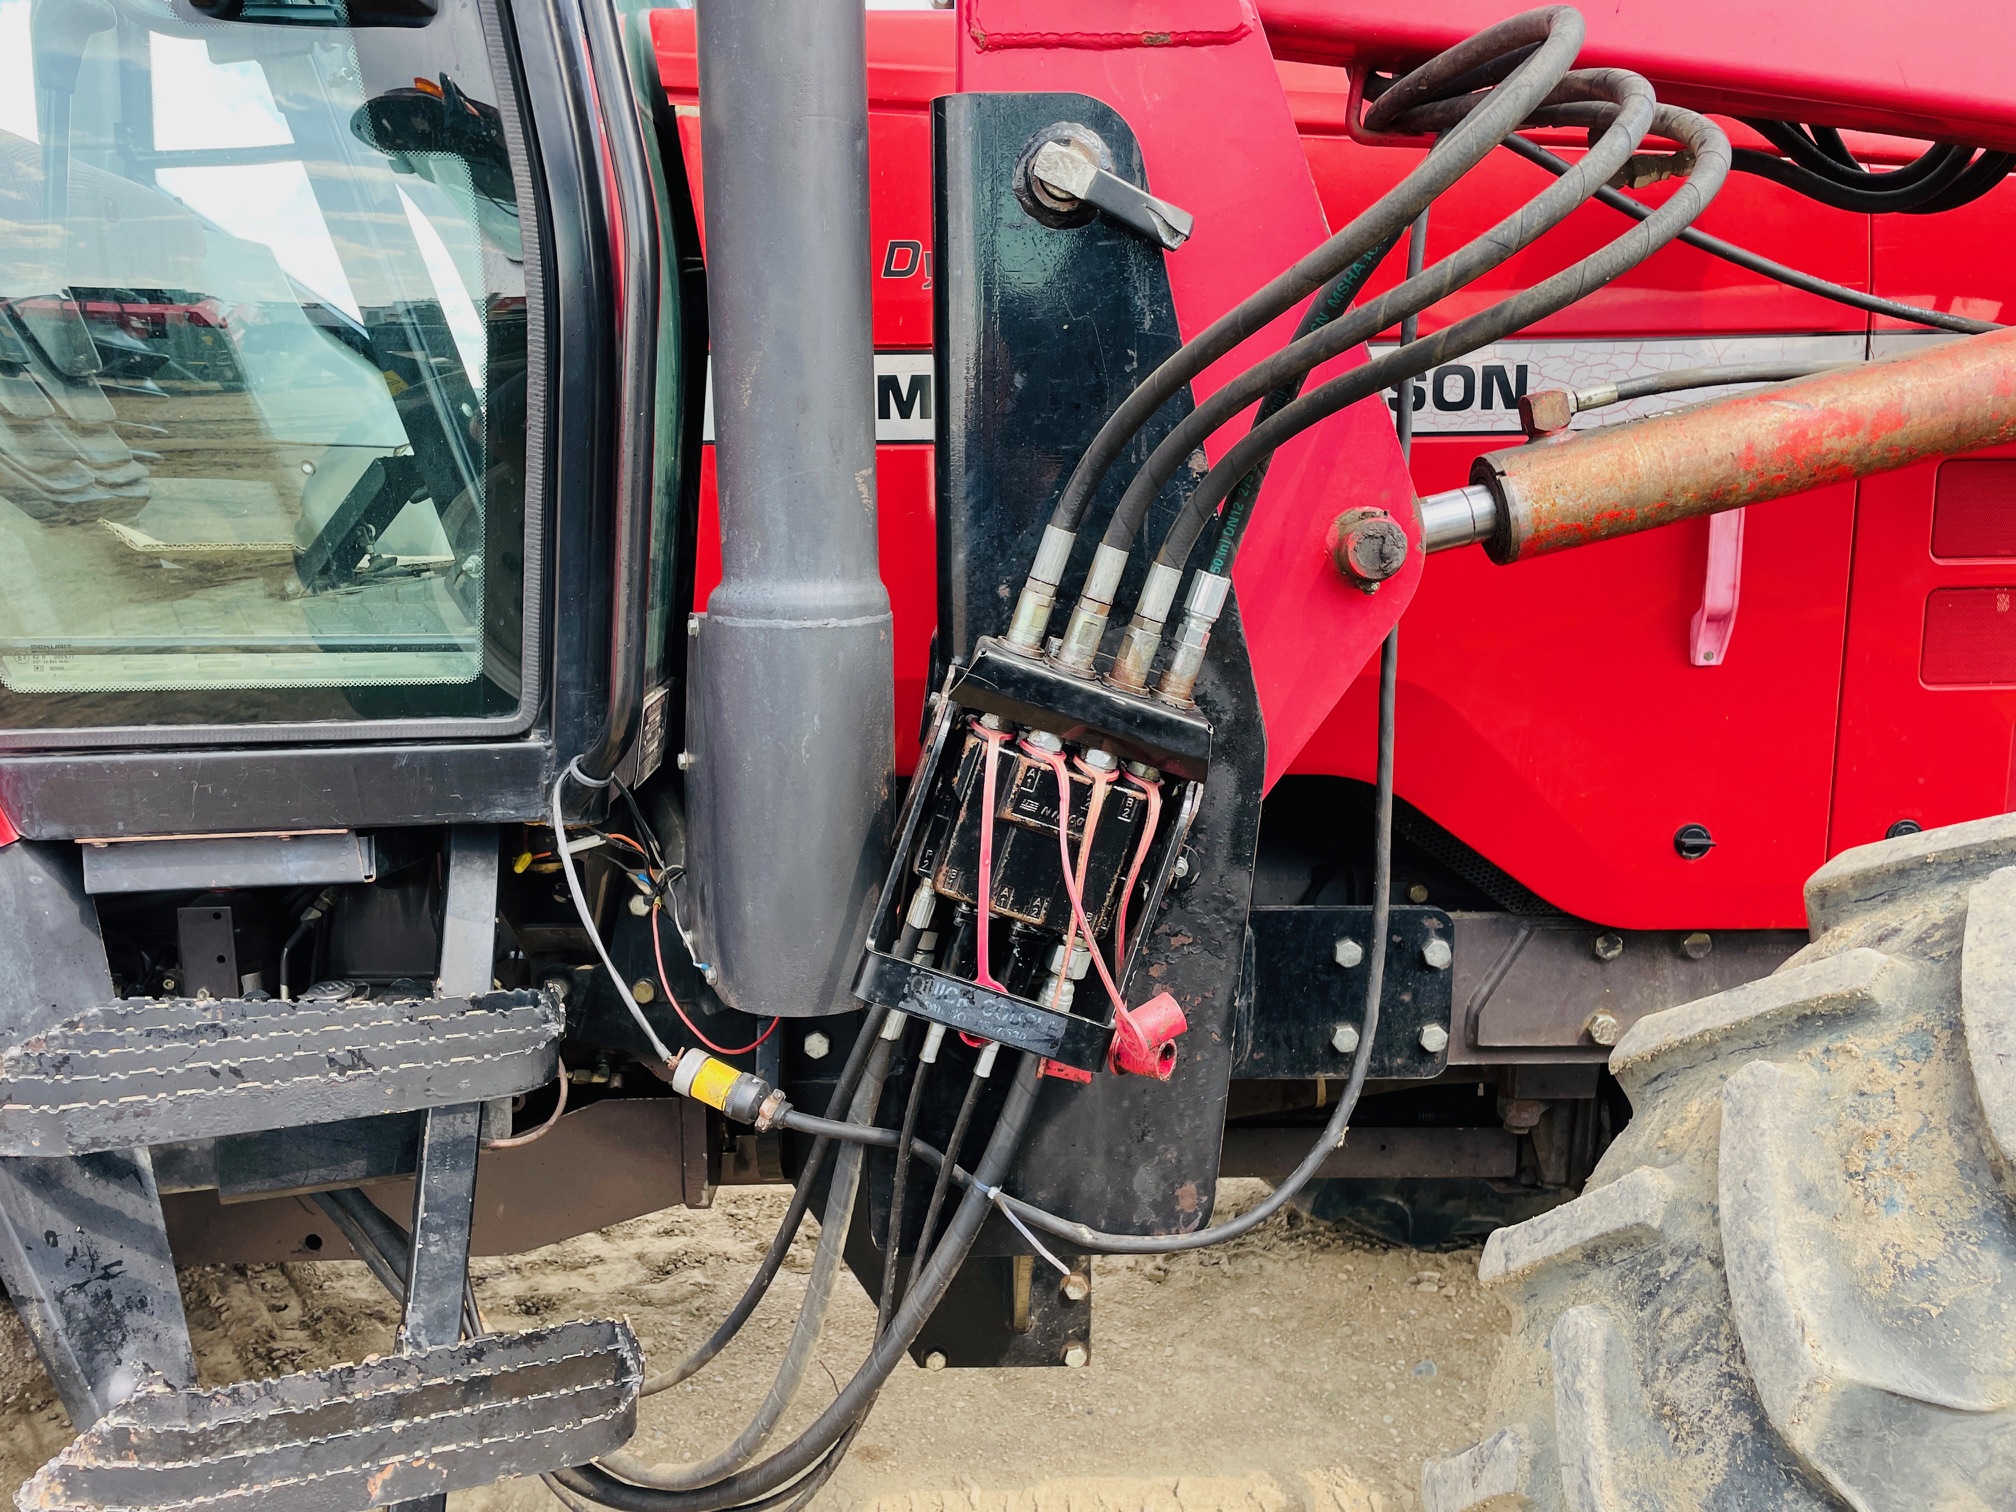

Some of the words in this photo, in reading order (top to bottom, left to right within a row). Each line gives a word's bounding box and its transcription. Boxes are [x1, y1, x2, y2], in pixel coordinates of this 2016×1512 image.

[878, 375, 932, 420] M
[1223, 502, 1244, 537] DN12
[1327, 261, 1365, 308] MSHA
